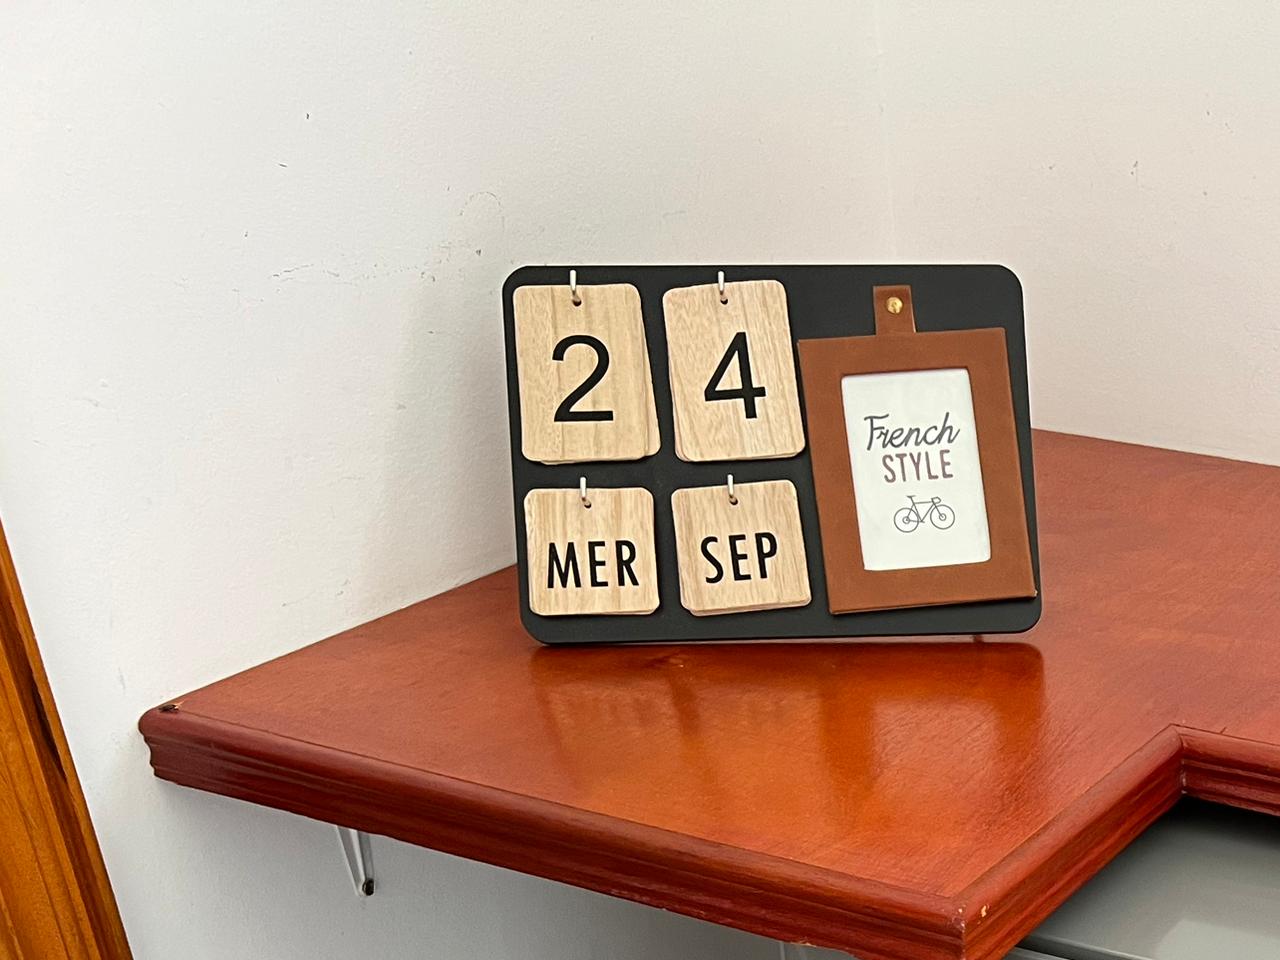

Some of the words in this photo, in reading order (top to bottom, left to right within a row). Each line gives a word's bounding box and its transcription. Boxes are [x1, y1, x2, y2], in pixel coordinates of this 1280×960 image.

[551, 334, 615, 423] 2
[703, 331, 767, 420] 4
[863, 411, 961, 451] French
[882, 449, 954, 484] STYLE
[547, 540, 640, 589] MER
[700, 531, 778, 584] SEP
